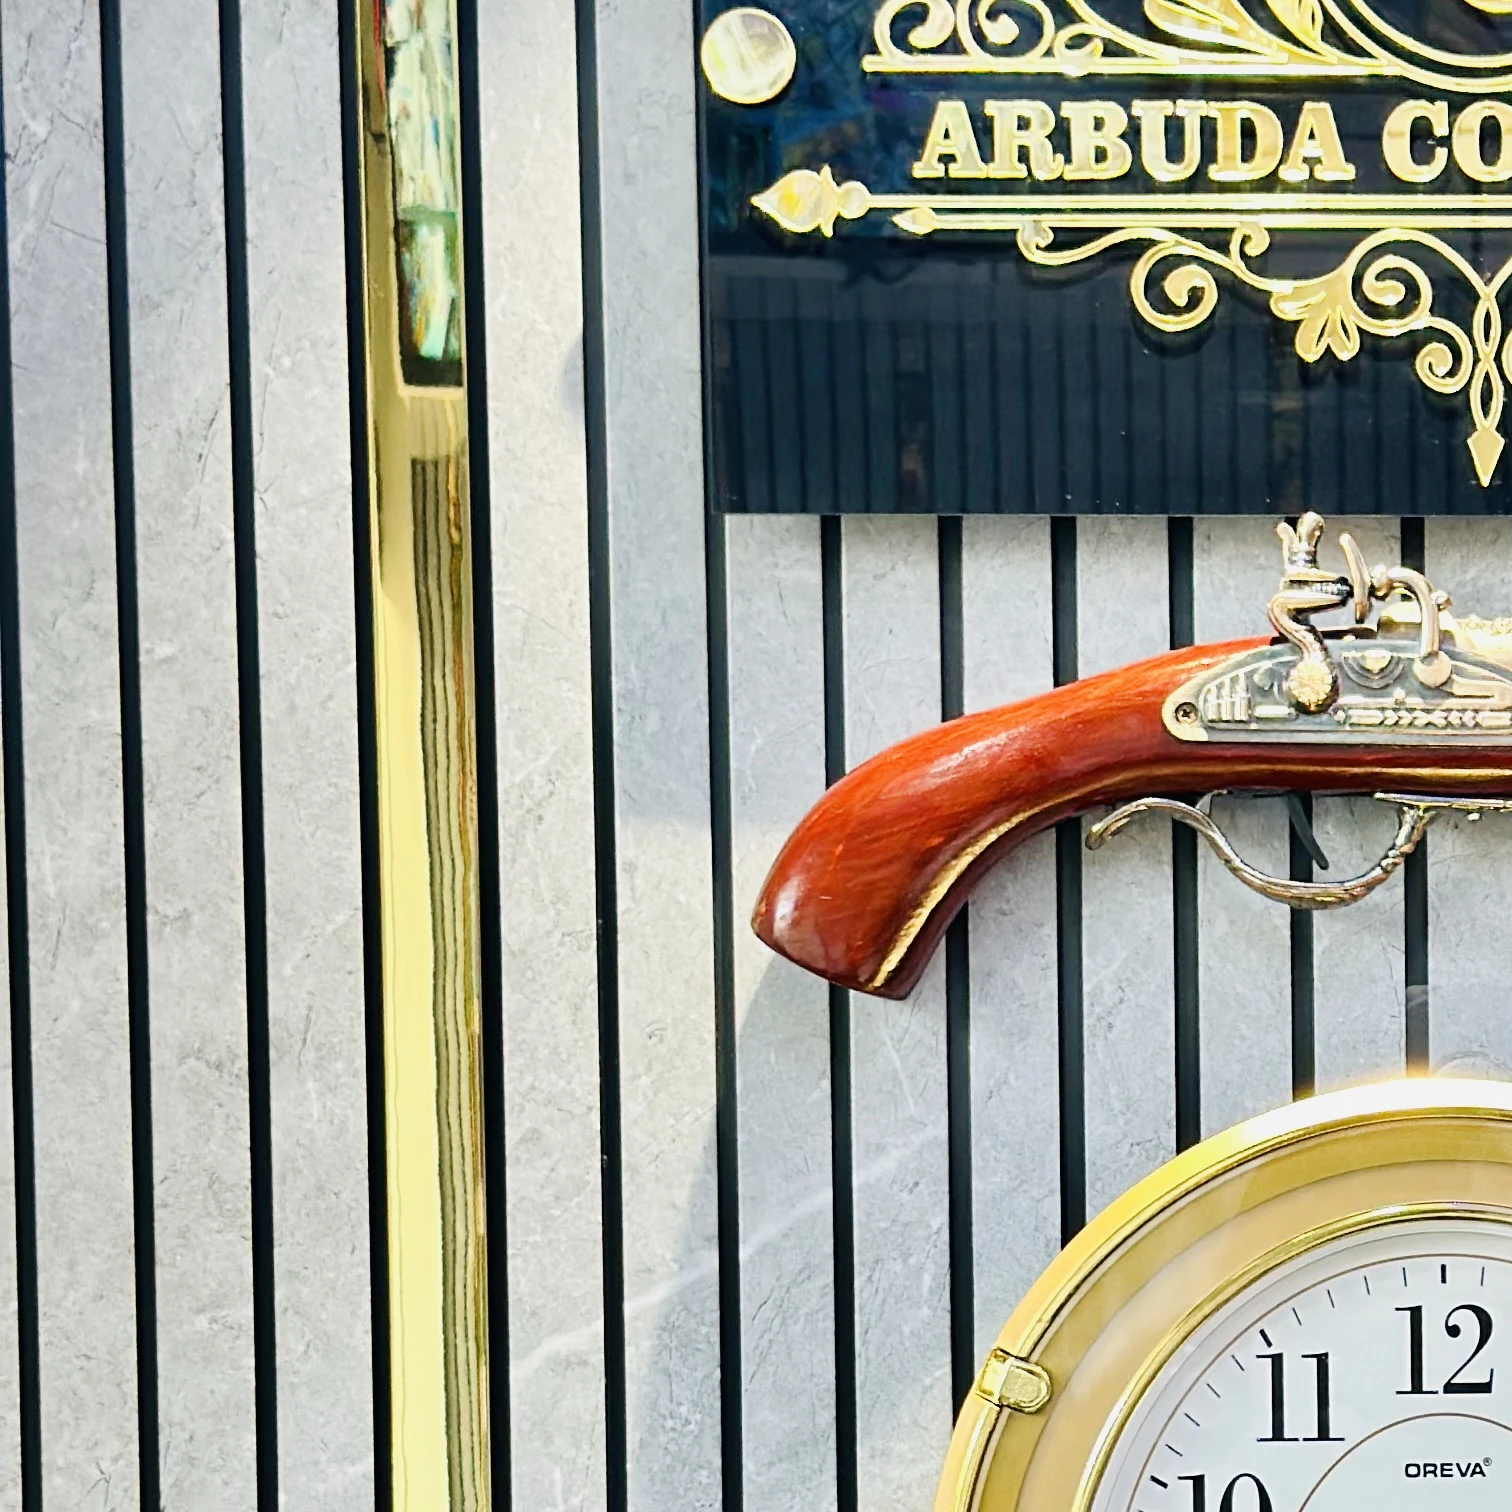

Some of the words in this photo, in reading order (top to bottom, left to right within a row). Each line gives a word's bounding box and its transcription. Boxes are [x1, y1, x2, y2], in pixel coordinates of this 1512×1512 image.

[912, 101, 1356, 182] ARBUDA
[1395, 1305, 1494, 1395] 12
[1256, 1351, 1346, 1442] 11
